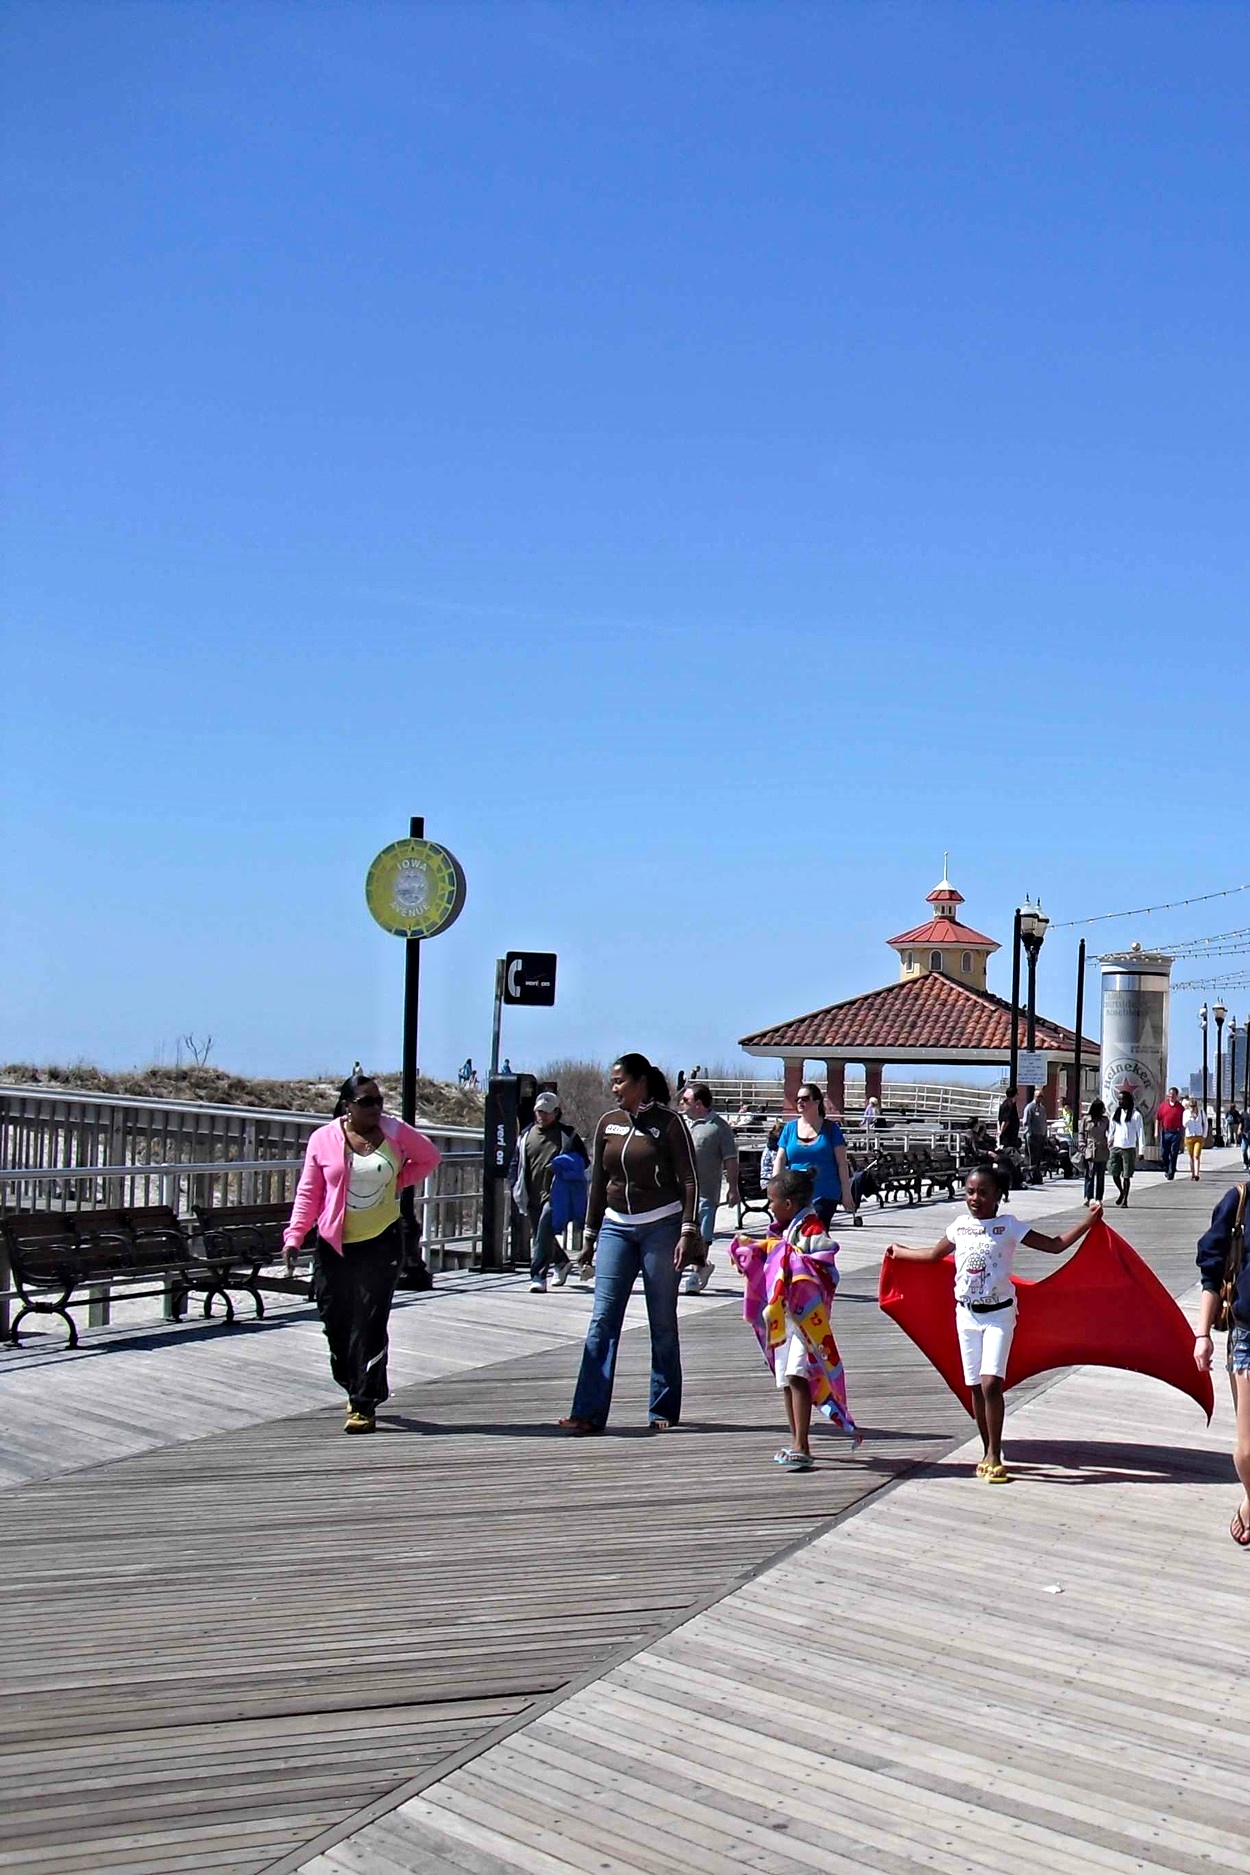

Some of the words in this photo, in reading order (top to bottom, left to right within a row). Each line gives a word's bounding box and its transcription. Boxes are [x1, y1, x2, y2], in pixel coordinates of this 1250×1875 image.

[397, 858, 428, 871] IOWA
[389, 901, 431, 917] AVENUE
[1103, 1062, 1153, 1089] Heineken
[496, 1124, 507, 1166] verion
